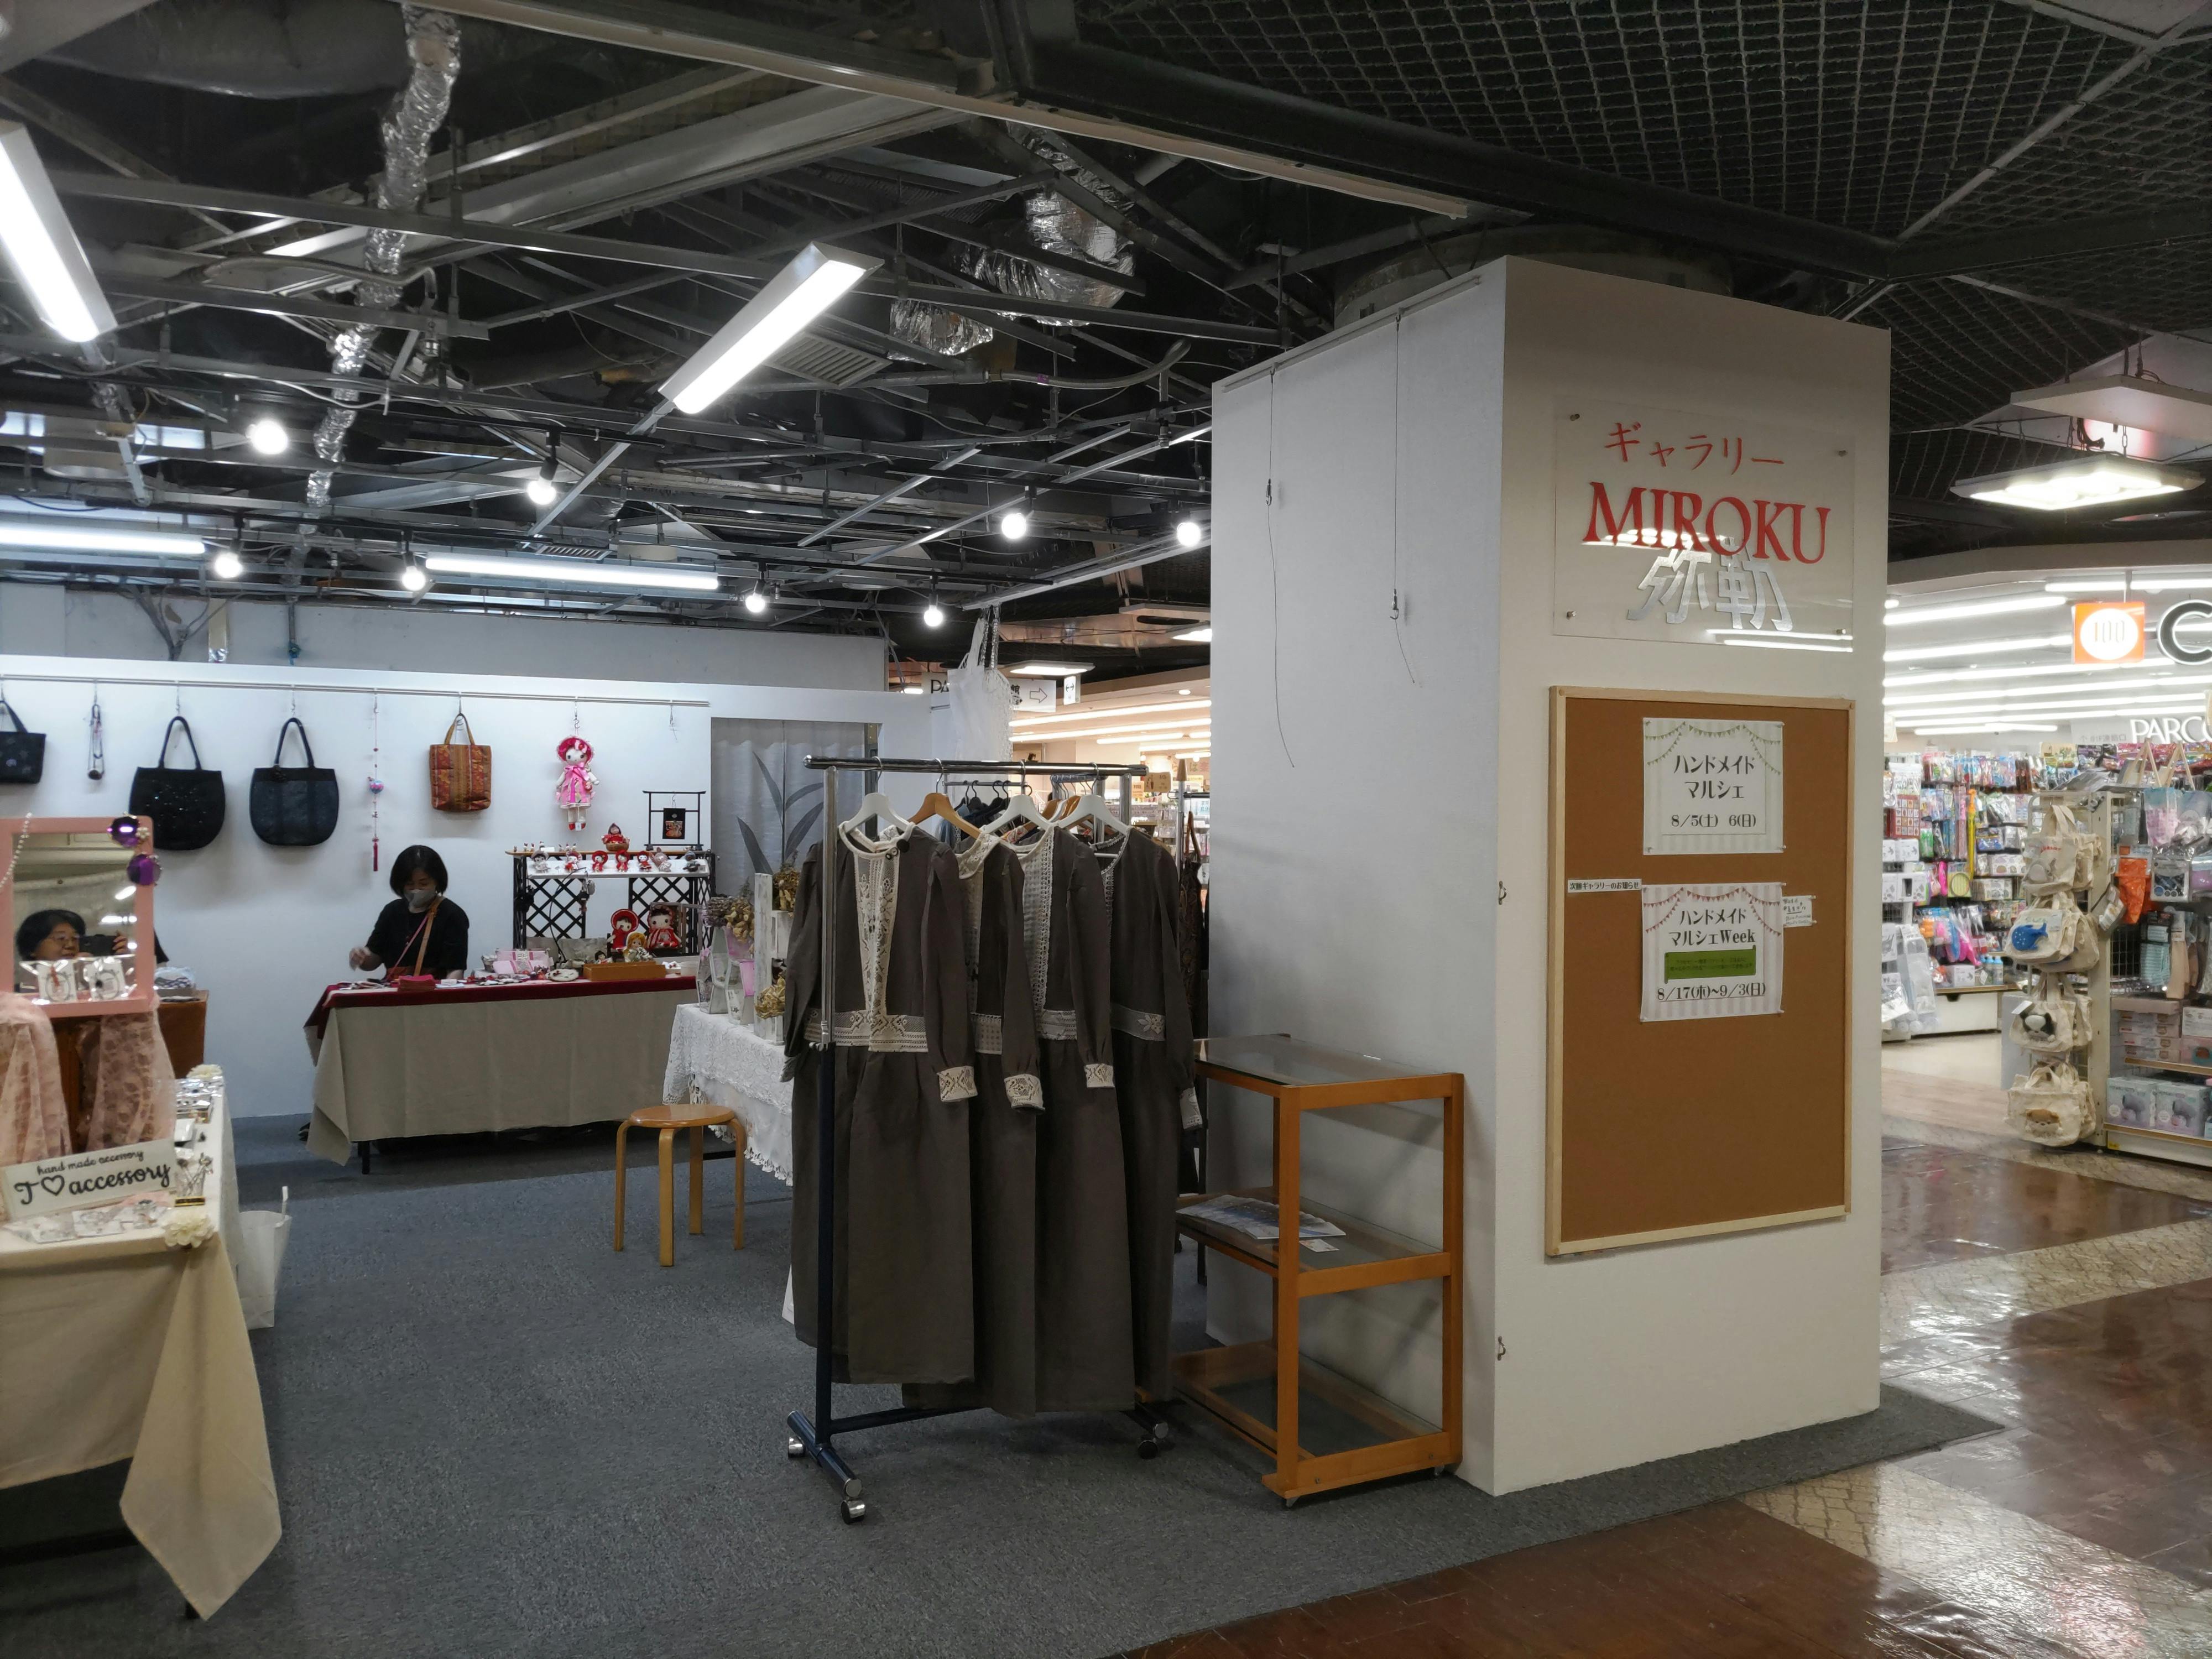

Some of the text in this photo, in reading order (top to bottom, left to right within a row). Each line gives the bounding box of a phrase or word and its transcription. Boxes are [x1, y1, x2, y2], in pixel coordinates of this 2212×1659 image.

[1605, 421, 1785, 475] ギャラリー
[1583, 482, 1831, 564] MIROKU
[1626, 536, 1793, 631] 弥勒
[2130, 716, 2212, 744] PARC
[1674, 755, 1755, 775] ハンドメイド
[1684, 780, 1744, 800] マルシェ
[1671, 814, 1756, 828] 8/5(土) 6(日)
[1569, 881, 1639, 890] 次回ギャラリーのお知らせ
[1679, 908, 1746, 926] ハンドメイド
[1670, 929, 1755, 947] マルシェWeek
[37, 1165, 65, 1176] hand
[69, 1164, 171, 1195] accessory
